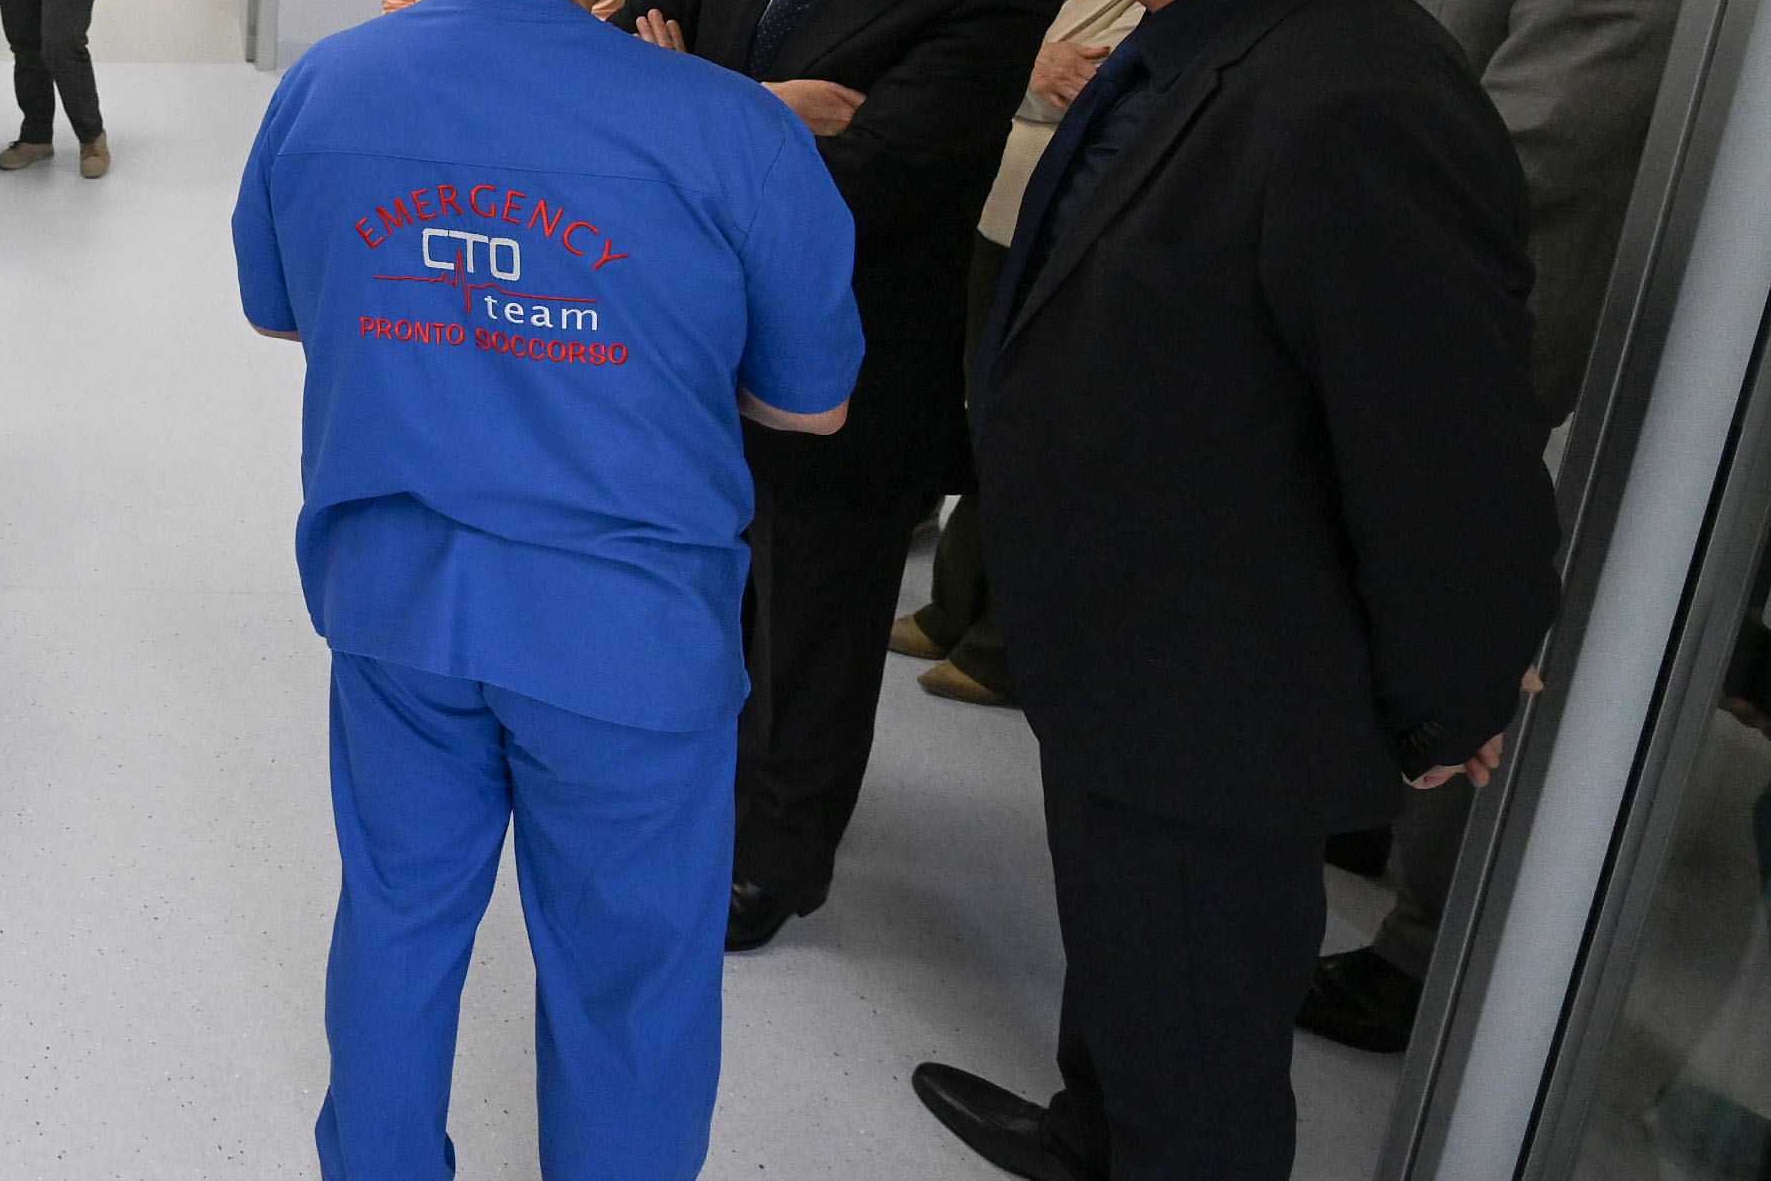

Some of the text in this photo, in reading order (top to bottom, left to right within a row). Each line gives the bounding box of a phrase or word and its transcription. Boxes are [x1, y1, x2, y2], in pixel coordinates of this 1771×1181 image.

[355, 185, 629, 270] EMERGENCY
[422, 228, 521, 281] CTO
[484, 295, 598, 331] team
[360, 317, 629, 365] PRONTO SOCCORSO
